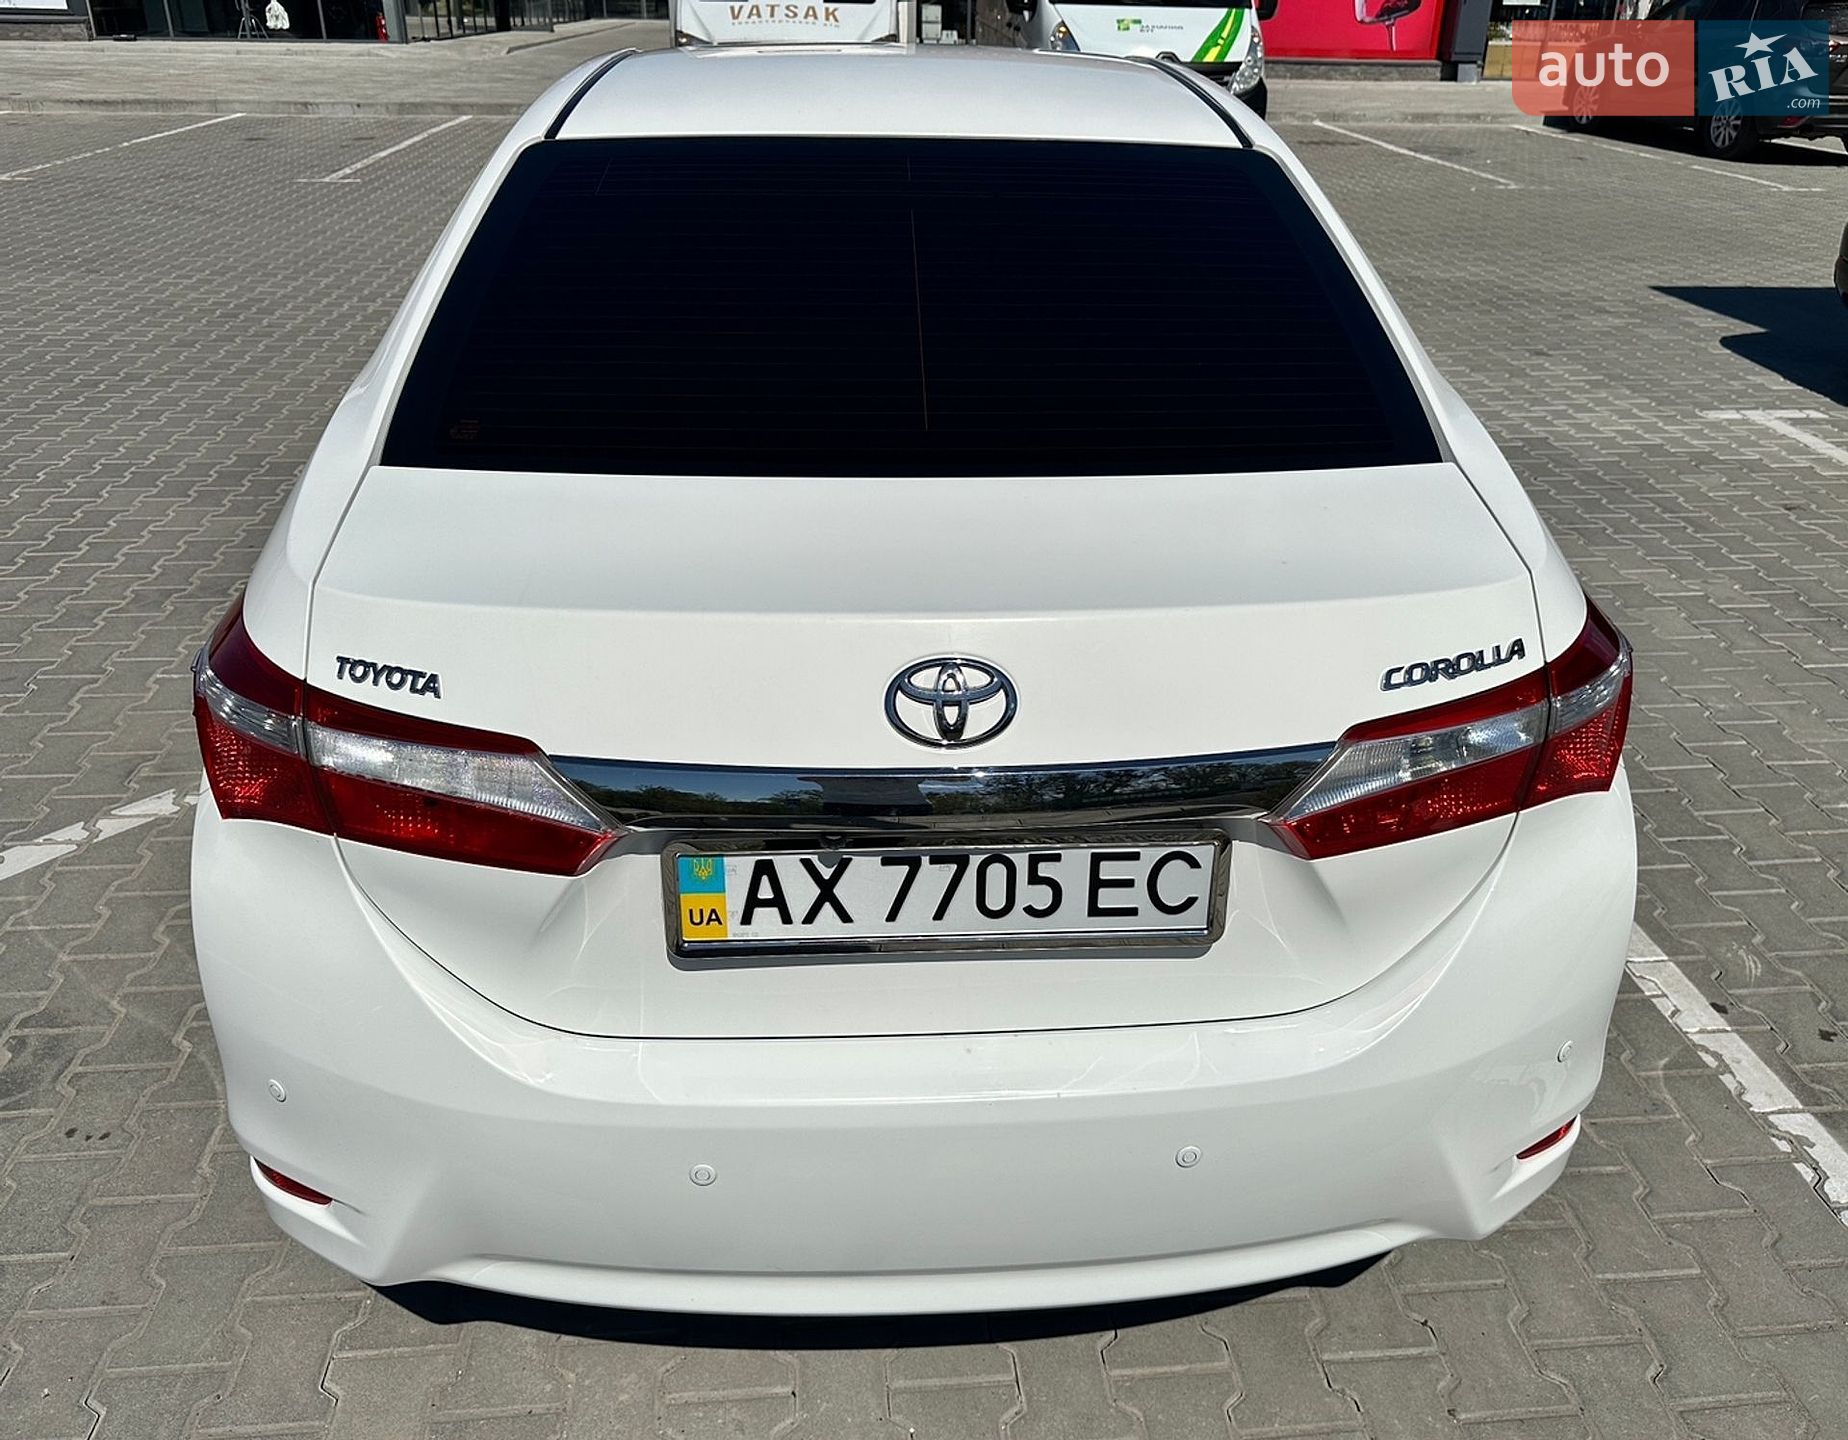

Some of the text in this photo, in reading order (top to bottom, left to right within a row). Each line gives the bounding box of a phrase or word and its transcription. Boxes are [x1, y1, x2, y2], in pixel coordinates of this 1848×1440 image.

[729, 4, 839, 23] VATSAK
[336, 655, 441, 699] TOYOTA
[1380, 637, 1526, 691] COROLLA
[740, 850, 1202, 926] AX 7705 EC
[688, 908, 723, 926] UA
